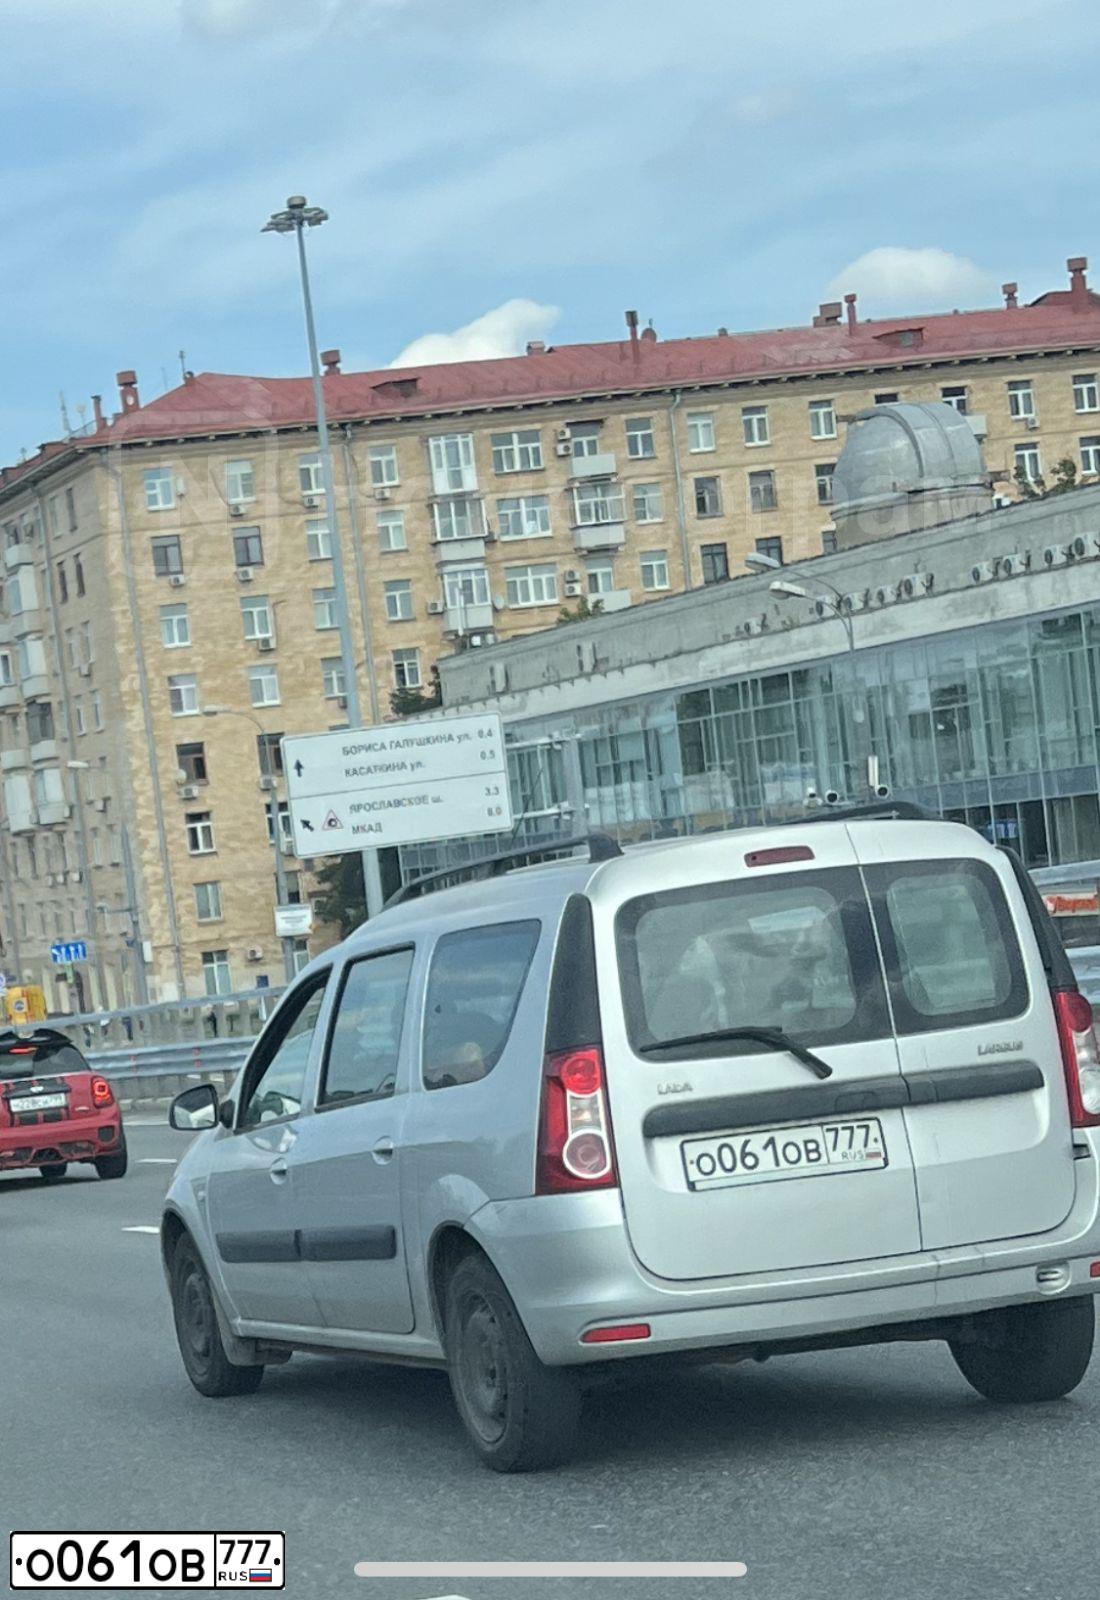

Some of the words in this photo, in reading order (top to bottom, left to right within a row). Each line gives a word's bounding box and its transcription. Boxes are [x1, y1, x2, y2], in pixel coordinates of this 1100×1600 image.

[342, 741, 387, 756] БОРИСА
[348, 795, 429, 814] ЯРОСЛАВСКОЕ
[351, 822, 383, 835] МКАД
[825, 1124, 870, 1152] 777
[841, 1151, 864, 1161] RUS
